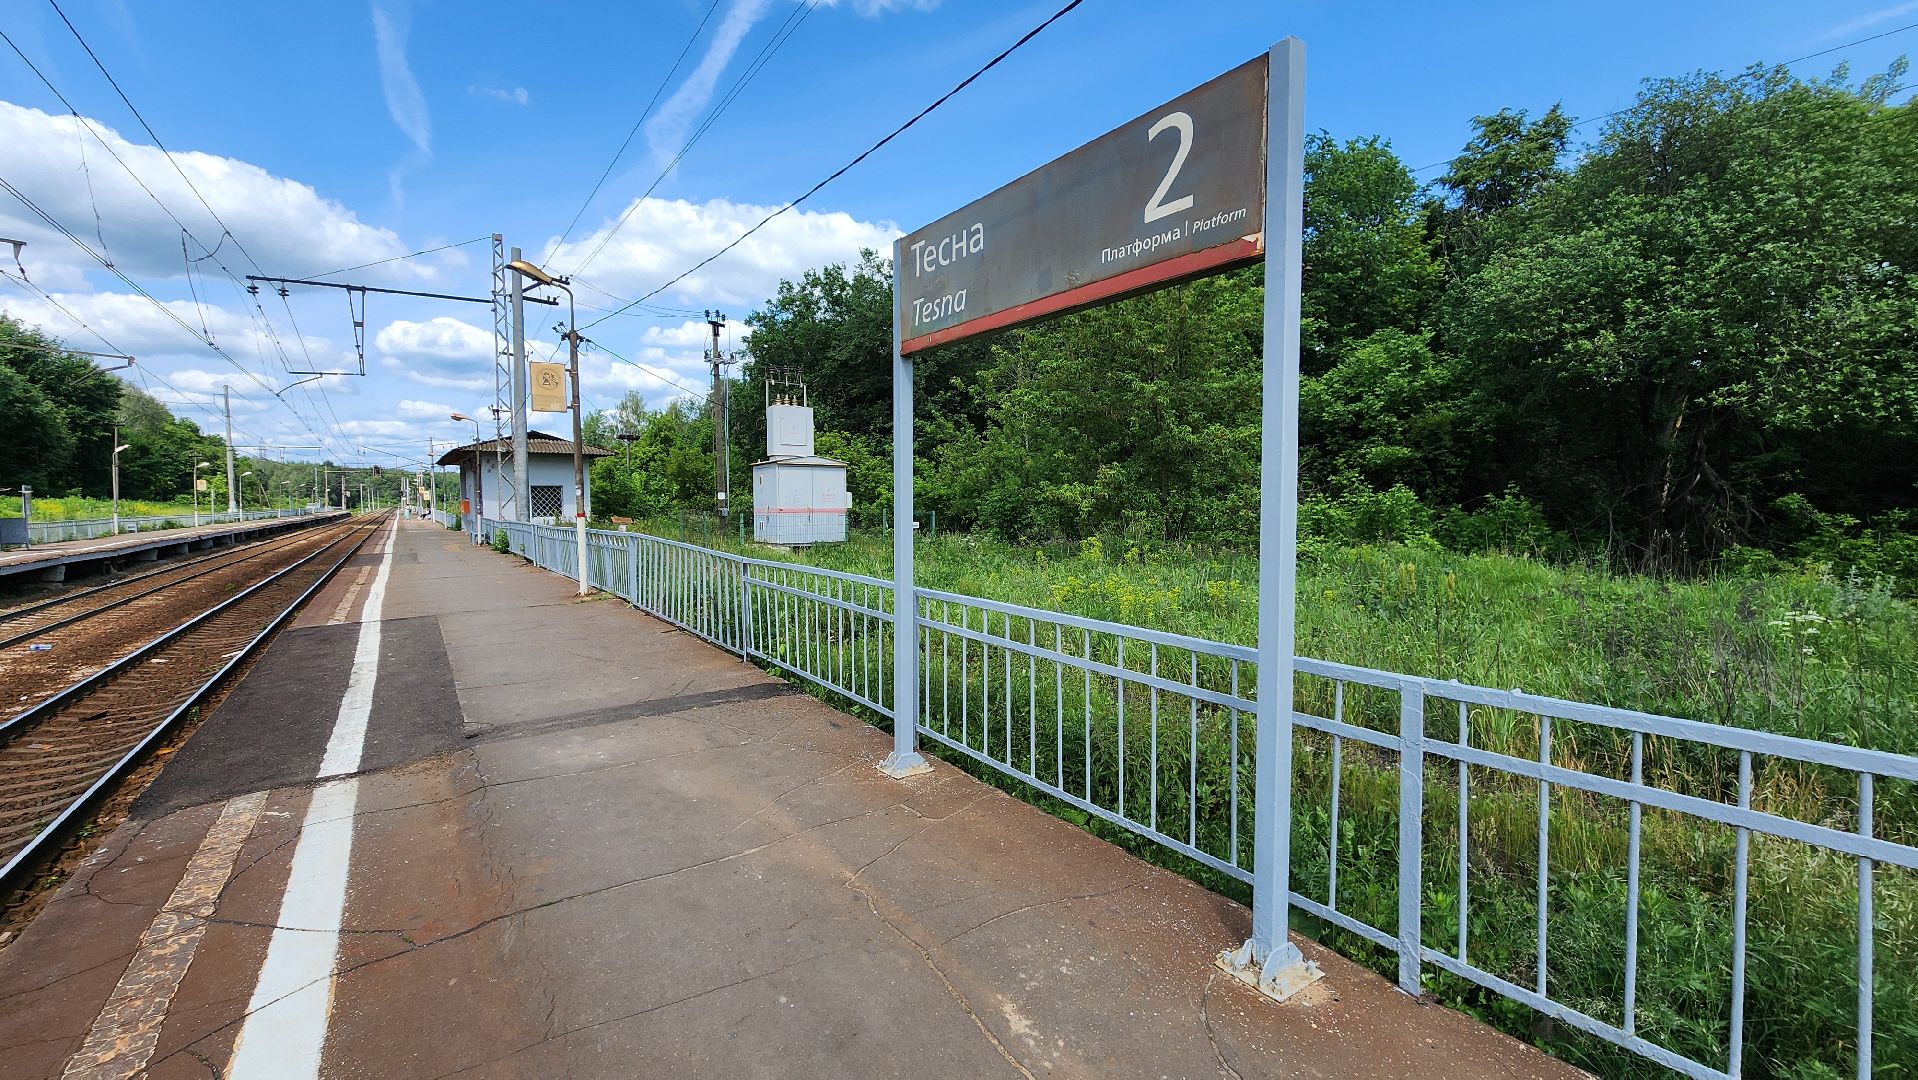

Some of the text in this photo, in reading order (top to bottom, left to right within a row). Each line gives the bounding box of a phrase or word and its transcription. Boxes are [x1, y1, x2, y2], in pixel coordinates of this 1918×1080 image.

[1144, 111, 1194, 224] 2
[910, 222, 984, 278] Тесна
[1101, 207, 1247, 264] Платформа Platform
[913, 288, 967, 327] Tesna
